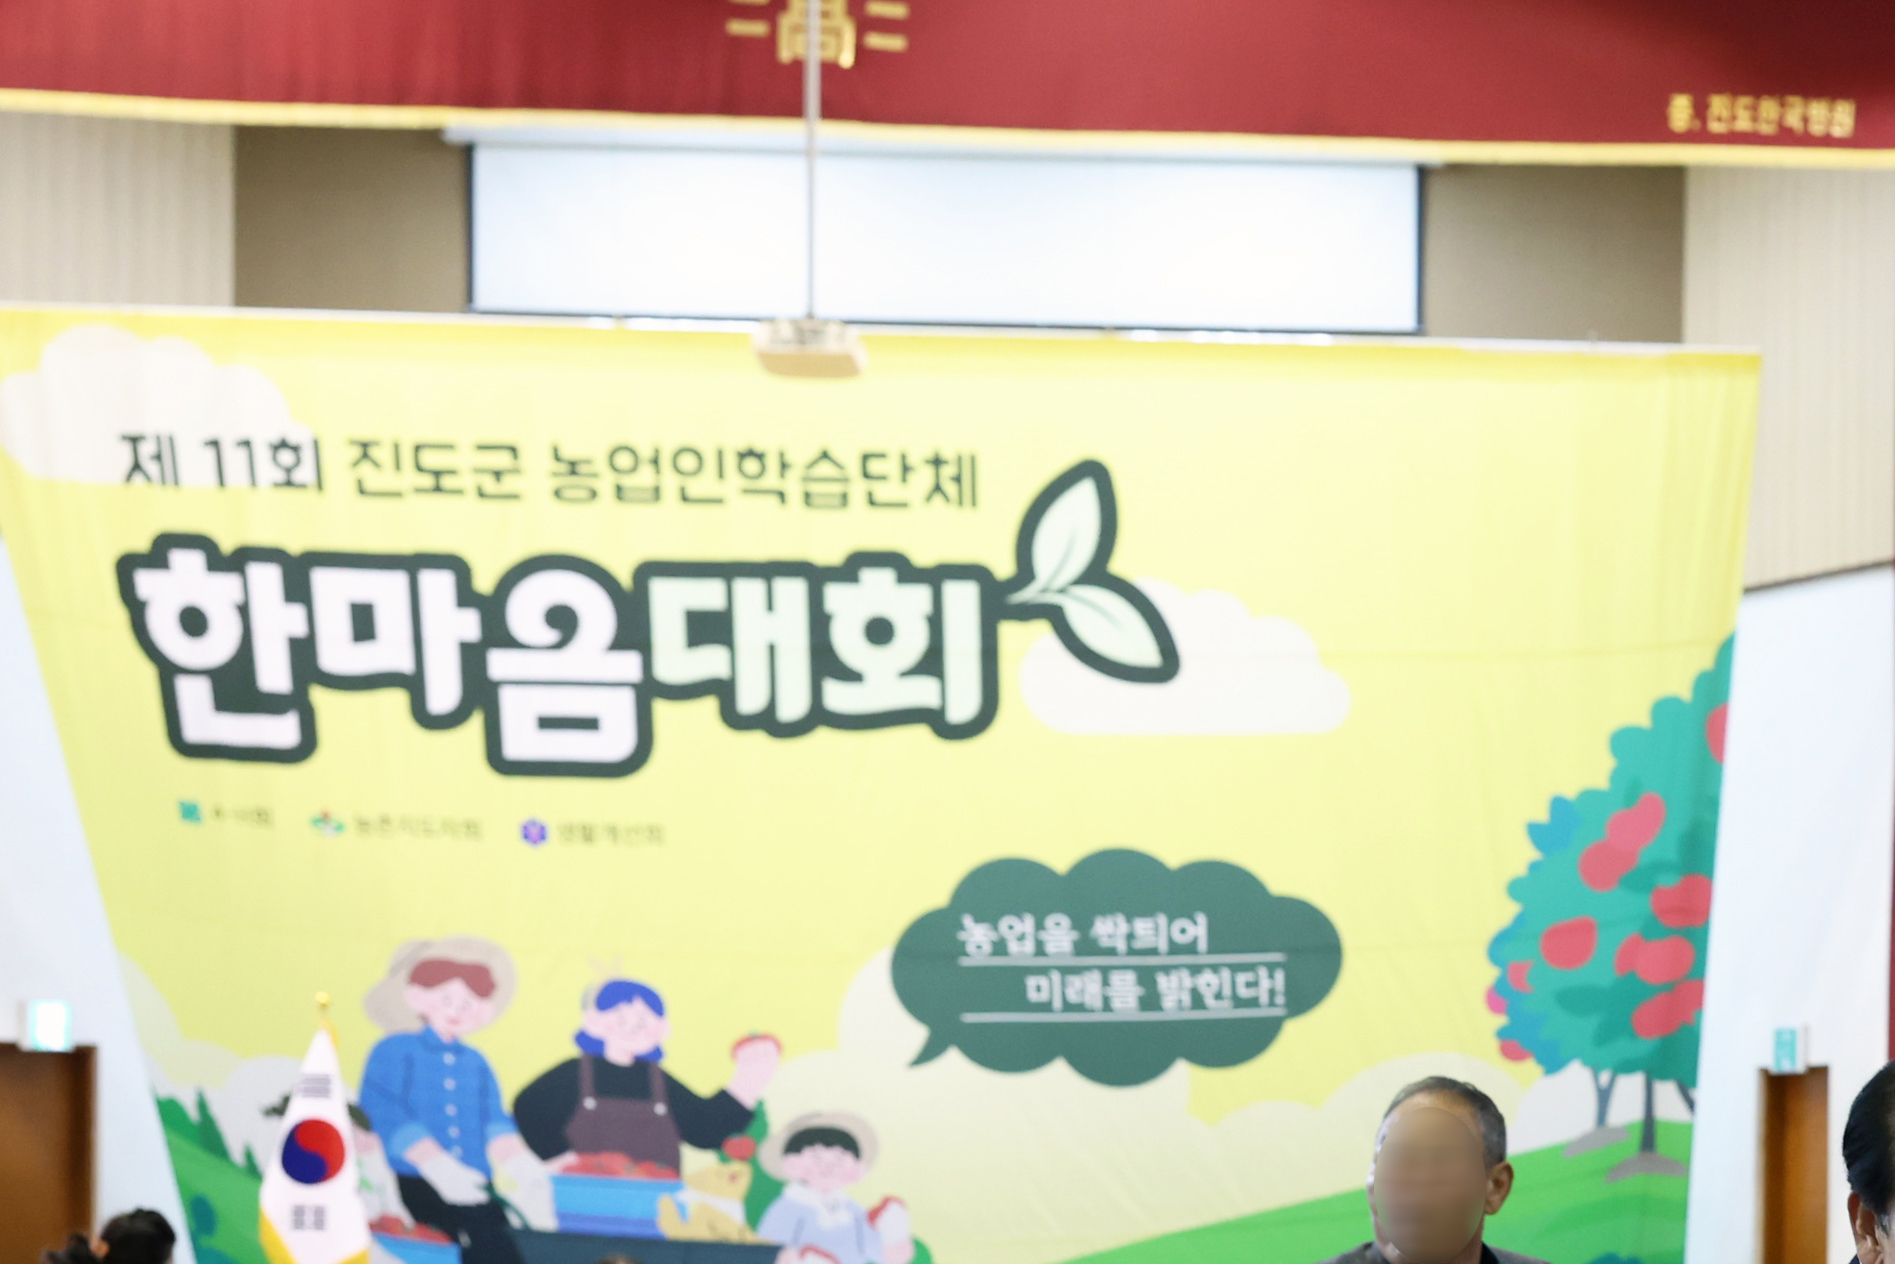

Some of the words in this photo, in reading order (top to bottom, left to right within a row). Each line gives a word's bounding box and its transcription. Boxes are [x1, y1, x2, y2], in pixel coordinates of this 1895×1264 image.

[120, 434, 179, 487] 제
[203, 435, 323, 491] 11회
[349, 438, 521, 500] 진도군
[550, 444, 977, 508] 농업인학습단체
[124, 540, 990, 770] 한마음대회
[956, 911, 1081, 957] 농업을
[1025, 967, 1145, 1013] 미래를
[1155, 966, 1286, 1012] 밝힌다!
